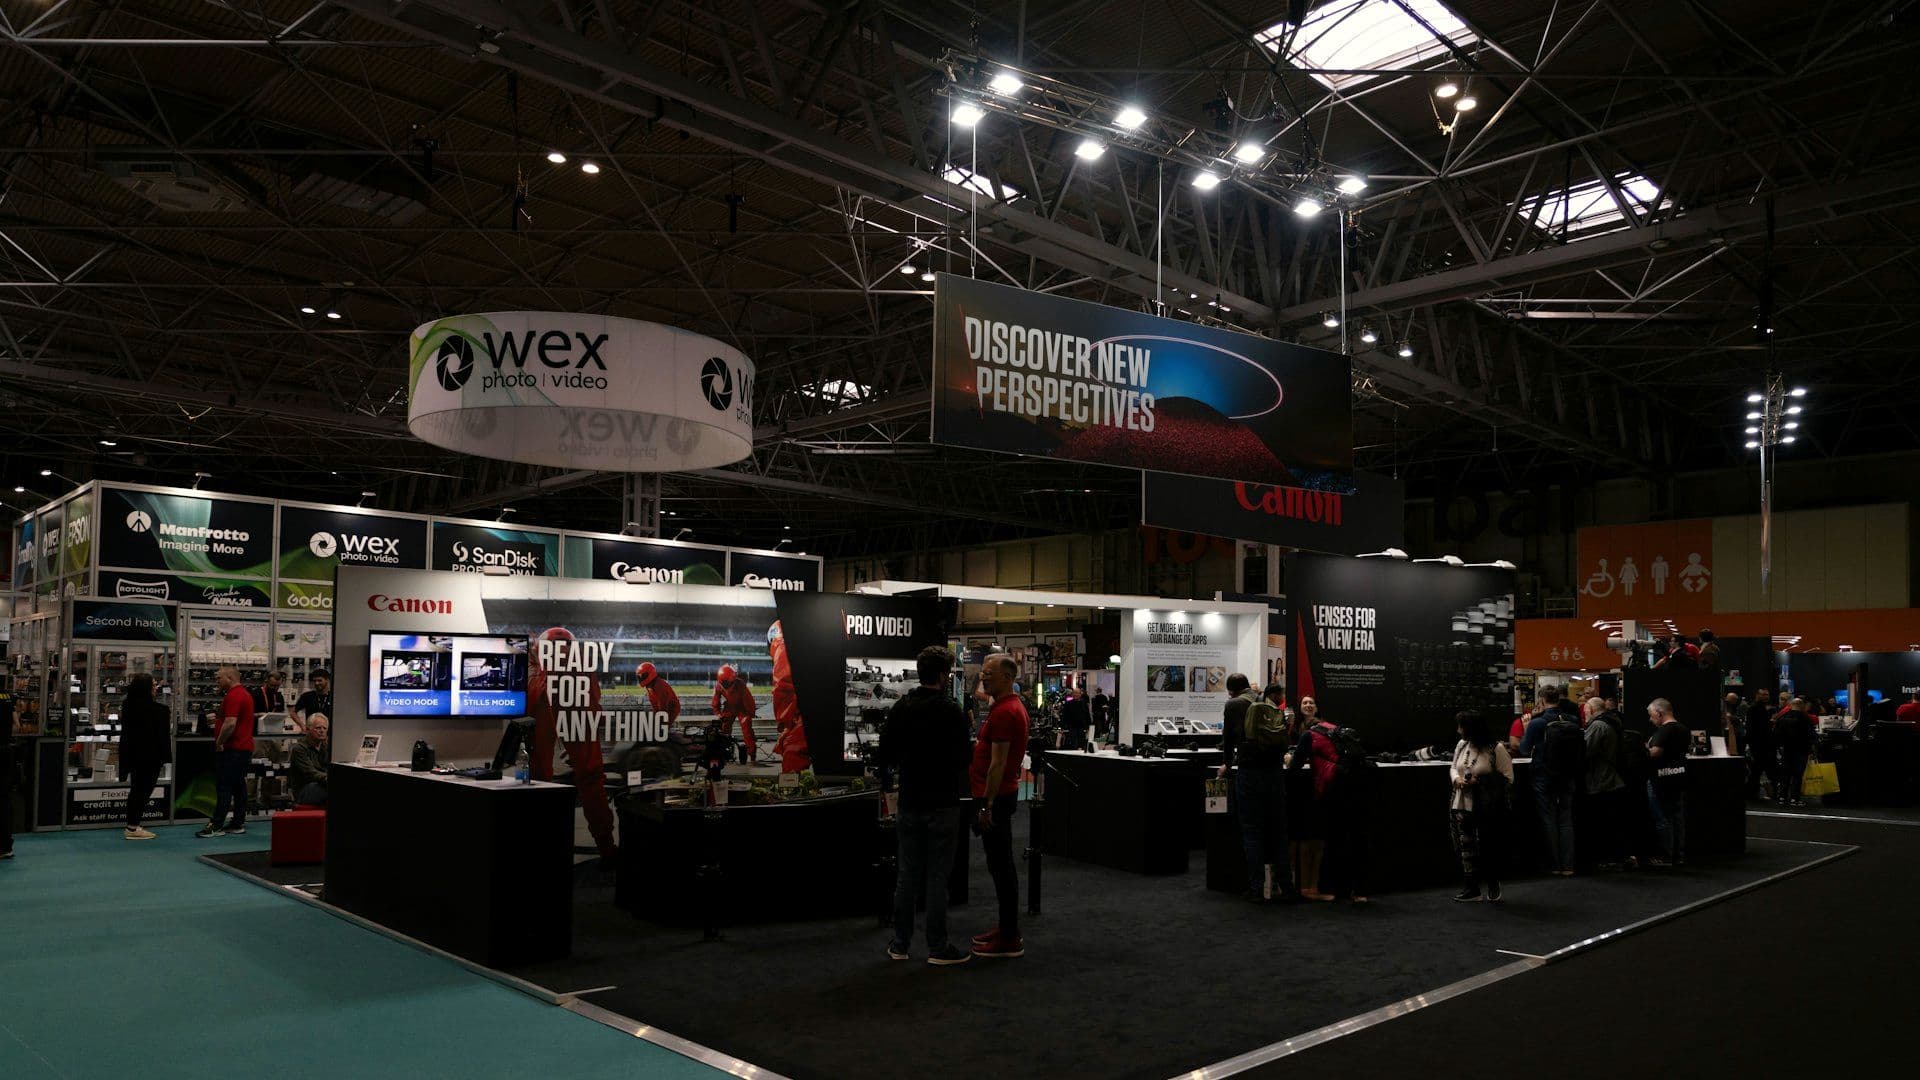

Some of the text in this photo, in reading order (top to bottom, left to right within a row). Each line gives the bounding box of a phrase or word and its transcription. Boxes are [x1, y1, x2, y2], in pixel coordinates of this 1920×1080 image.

[483, 330, 609, 370] wex
[964, 316, 1151, 388] DISCOVER NEW
[482, 371, 608, 392] photo video
[976, 366, 1155, 433] PERSPECTIVES
[66, 514, 91, 548] EPSON
[159, 539, 245, 555] Imagine More
[340, 533, 400, 556] wex
[340, 552, 400, 564] photo video
[472, 547, 538, 569] SanDisk
[119, 586, 167, 595] ROTOLIGHT
[367, 594, 452, 614] Canon
[85, 615, 165, 628] Second hand
[846, 614, 913, 637] PRO VIDEO
[1147, 622, 1193, 634] GET MORE WITH
[1312, 605, 1376, 629] LENSES FOR
[1150, 633, 1208, 646] OUR RANGE OF APPS
[1318, 628, 1376, 651] A NEW ERA
[538, 640, 614, 673] READY
[546, 675, 591, 708] FOR
[555, 710, 669, 743] ANYTHING
[1657, 766, 1686, 777] Nikon
[83, 801, 112, 809] credit
